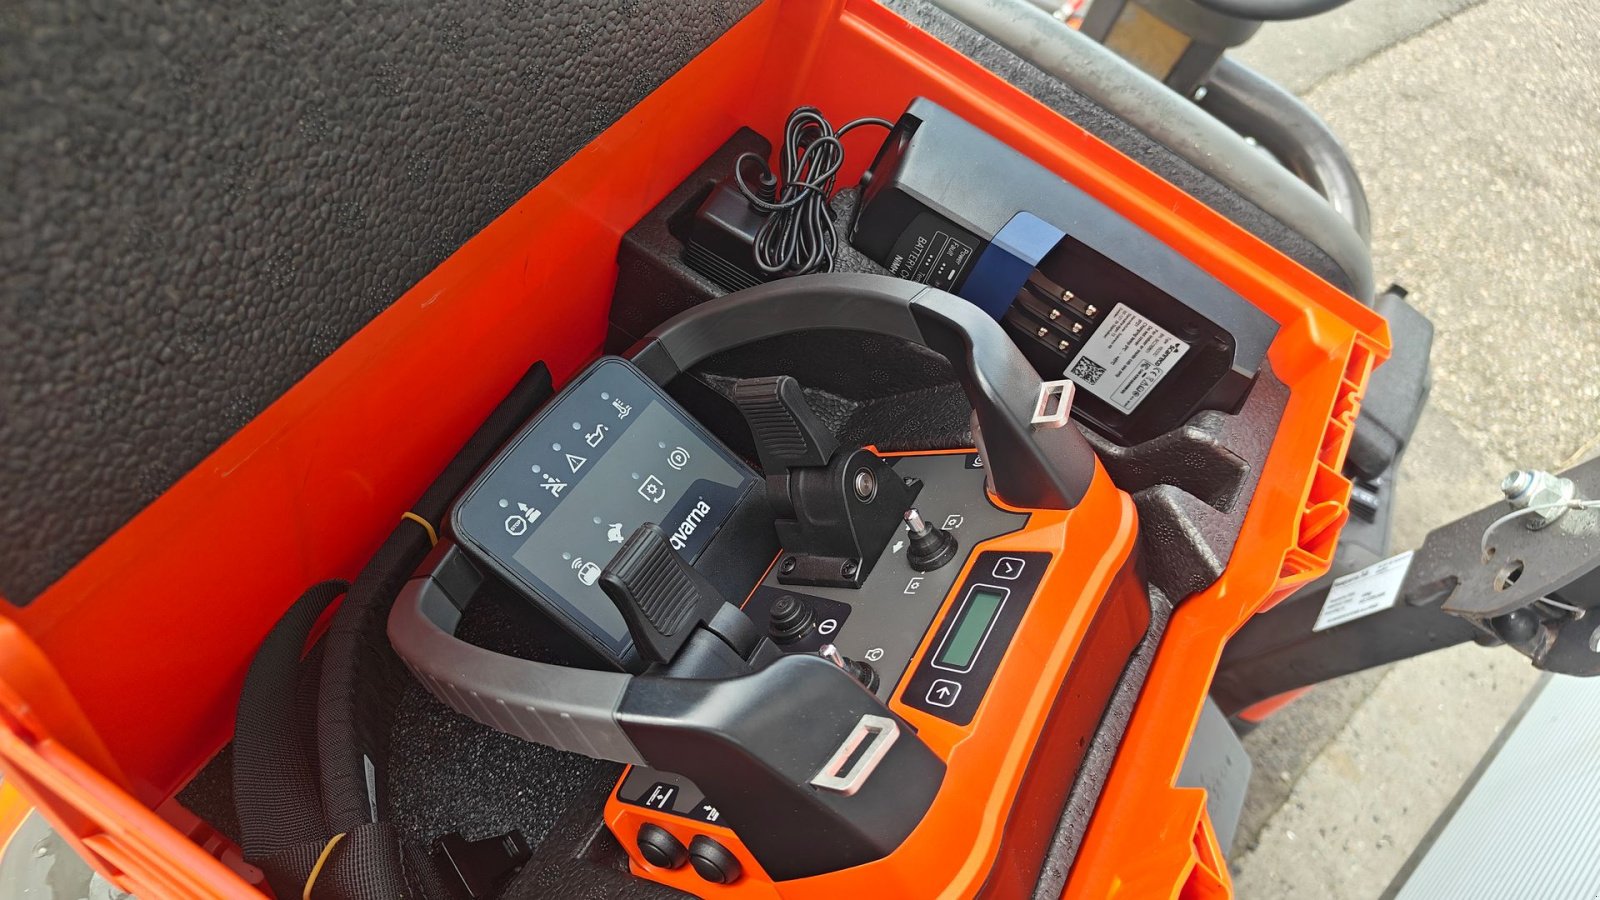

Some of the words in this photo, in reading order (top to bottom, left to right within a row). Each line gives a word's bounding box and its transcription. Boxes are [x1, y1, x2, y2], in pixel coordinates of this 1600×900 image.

[904, 236, 927, 270] BATTERY
[946, 241, 960, 257] Fault
[955, 248, 969, 265] Power
[888, 254, 903, 274] NiMH
[1154, 345, 1176, 367] scanreco
[669, 500, 710, 550] qvarna
